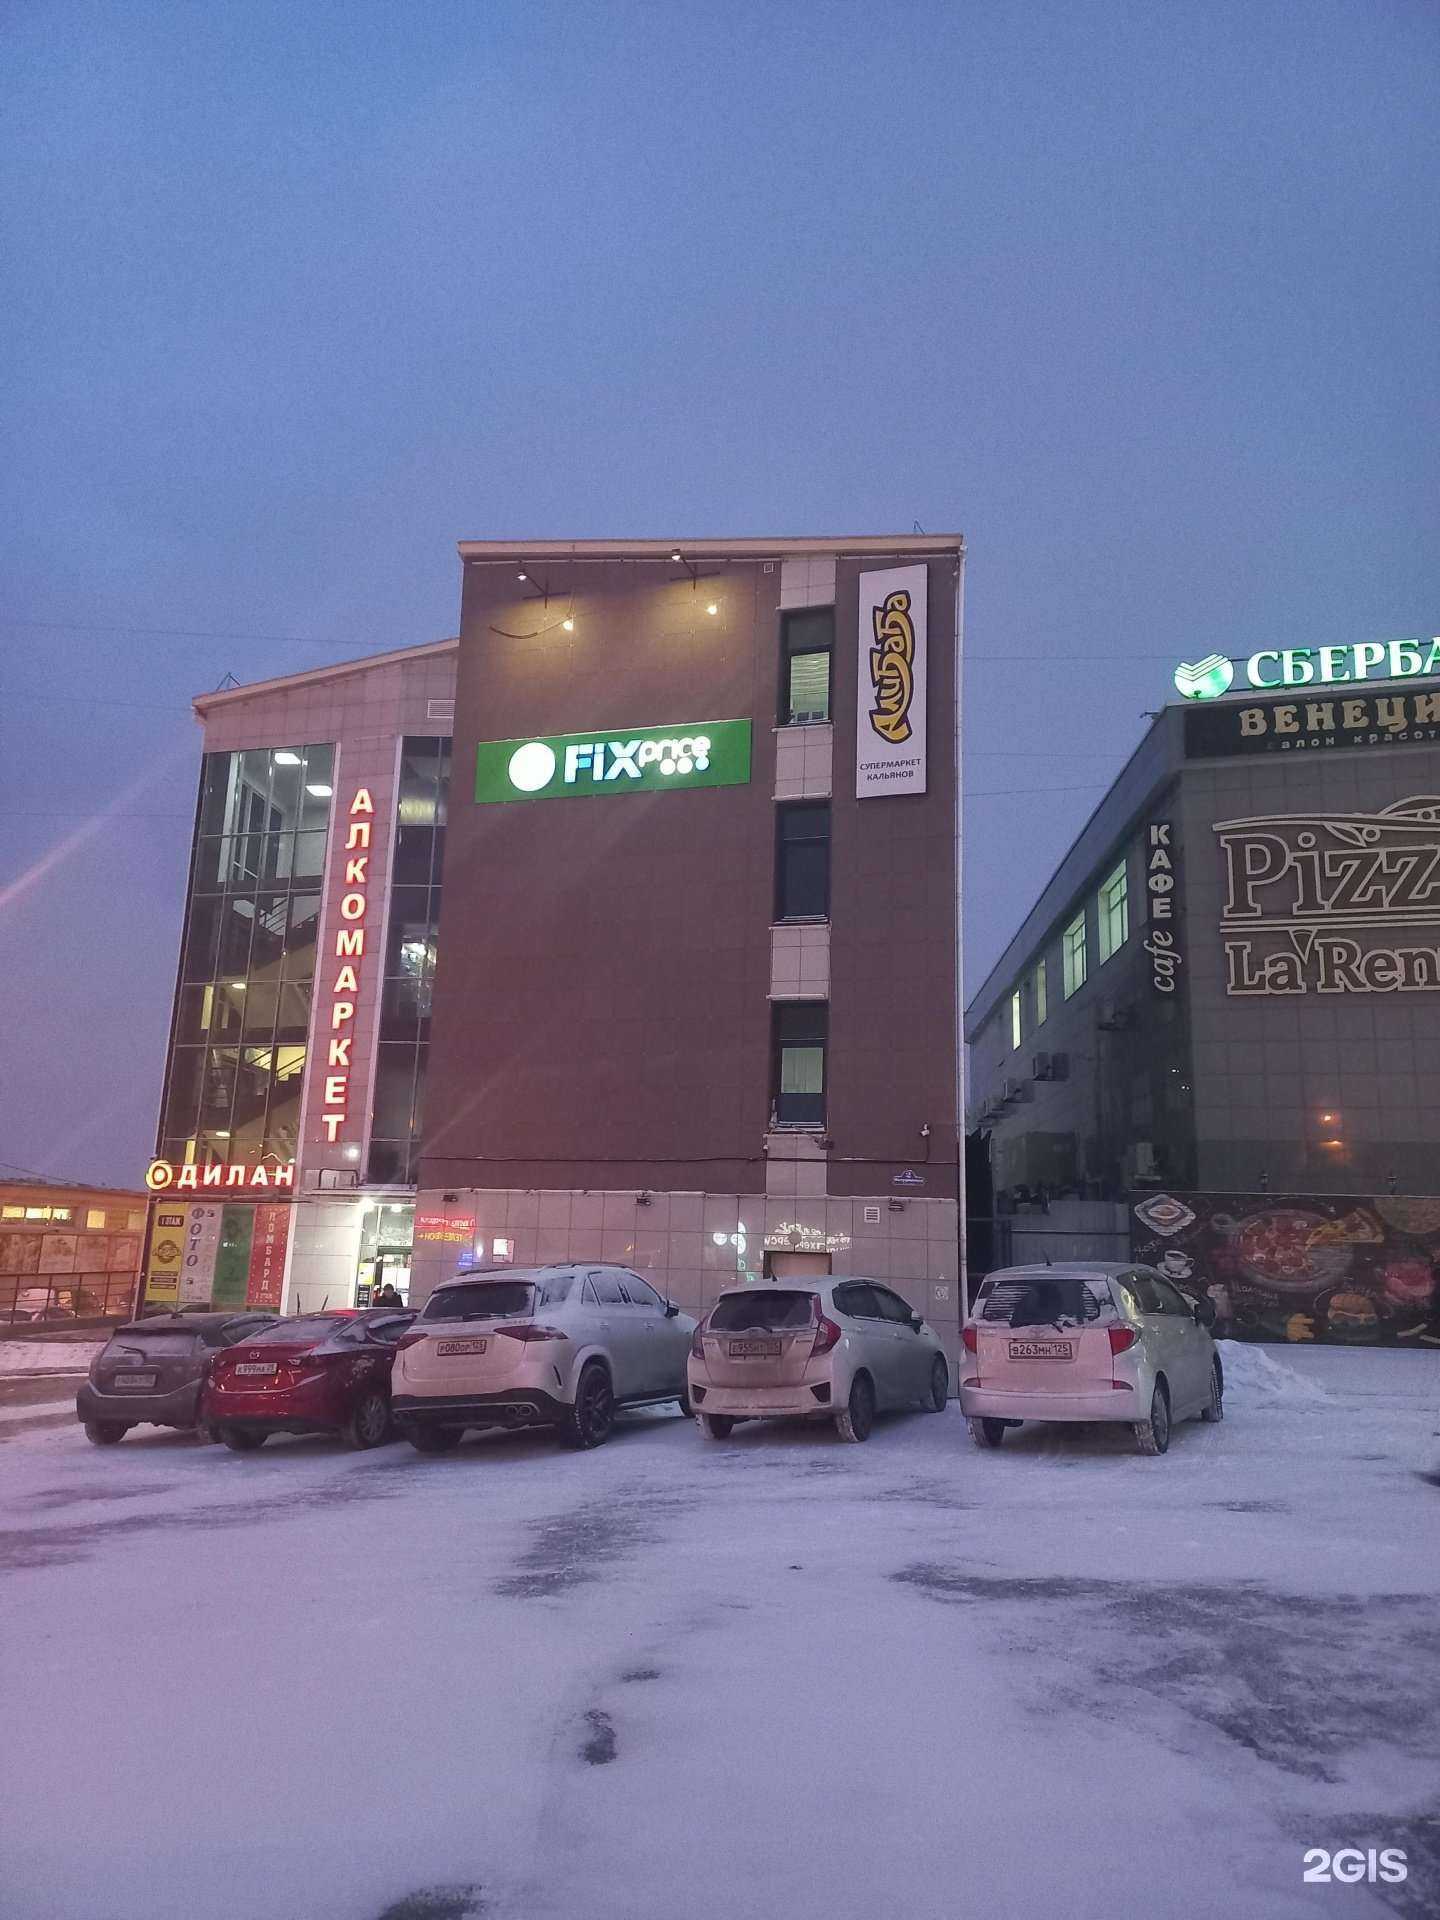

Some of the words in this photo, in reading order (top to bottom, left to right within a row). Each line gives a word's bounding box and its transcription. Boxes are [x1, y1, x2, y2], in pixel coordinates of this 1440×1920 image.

[1239, 692, 1440, 737] ВЕНЕЦИ
[638, 735, 712, 768] price
[1266, 736, 1335, 750] алон
[1353, 729, 1437, 744] красот
[860, 758, 922, 771] СУПЕРМАРКЕТ
[867, 769, 914, 781] КАЛЬЯНОВ
[1149, 824, 1174, 919] КАФЕ
[321, 787, 374, 1143] АЛКОМАРКЕТ
[1143, 930, 1182, 992] cafe
[177, 1163, 294, 1190] ДИЛАН
[186, 1207, 205, 1267] ФОТО
[261, 1211, 276, 1291] ЛОМБАРД
